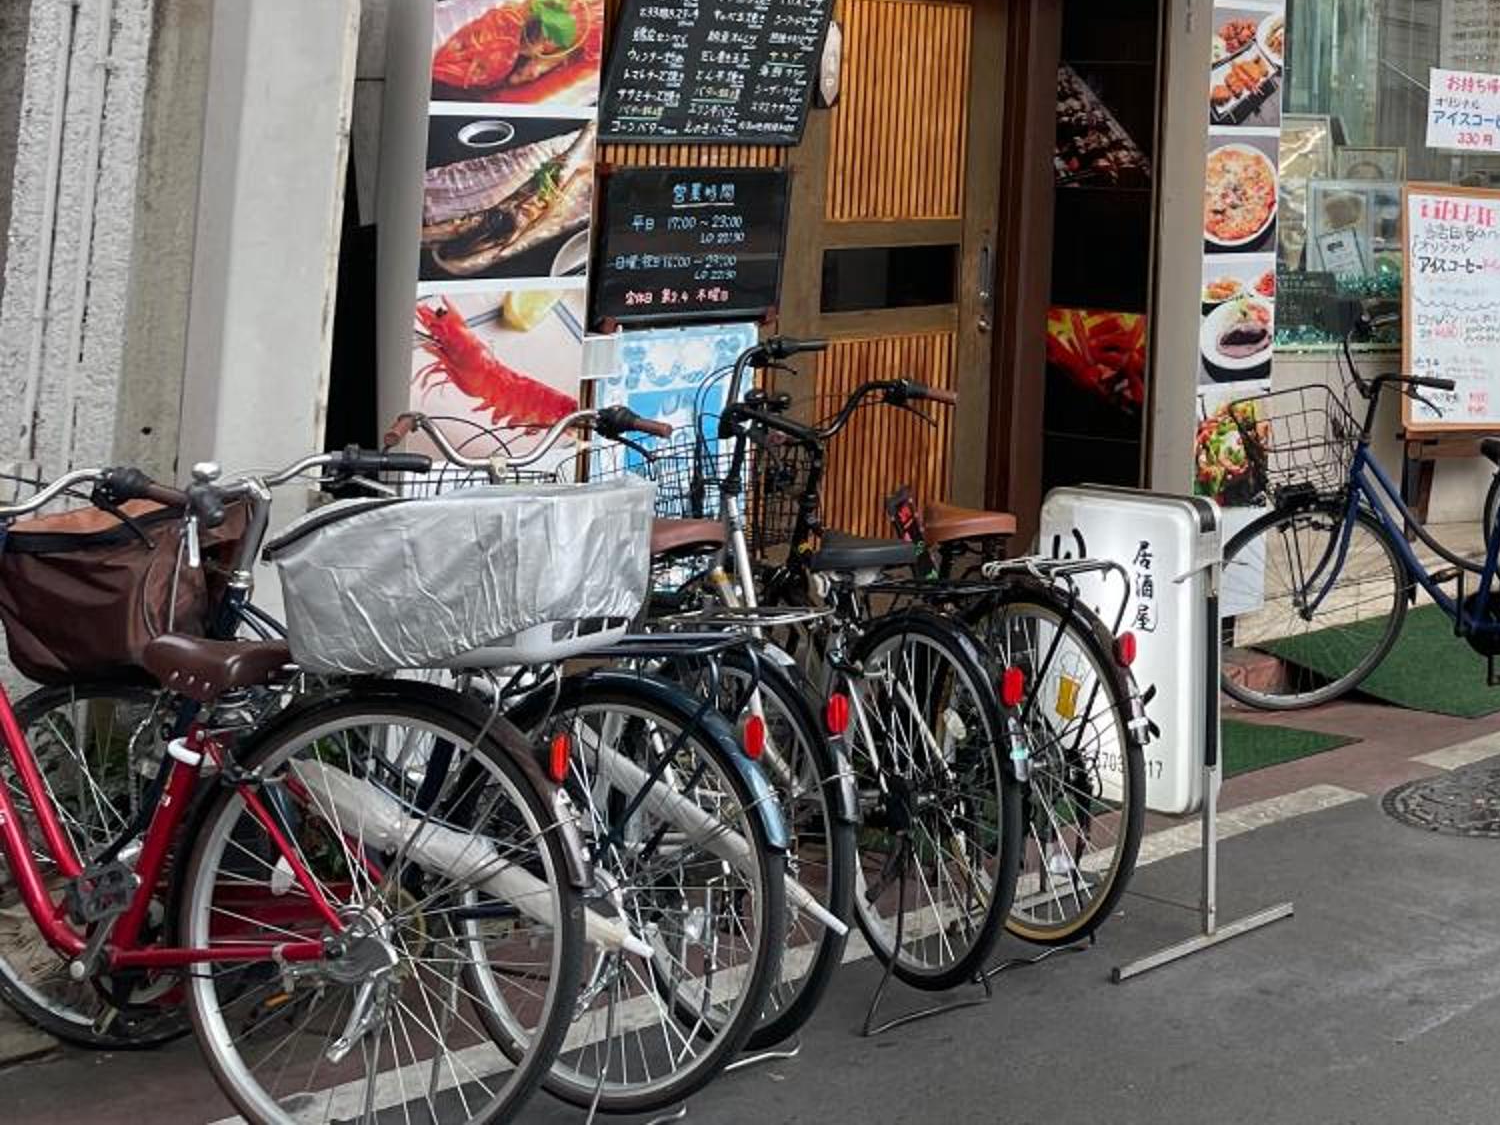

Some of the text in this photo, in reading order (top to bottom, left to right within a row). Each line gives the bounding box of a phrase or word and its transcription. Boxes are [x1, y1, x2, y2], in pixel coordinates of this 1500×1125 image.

[1418, 256, 1483, 274] アイスコーヒー
[1131, 540, 1157, 633] 居酒屋
